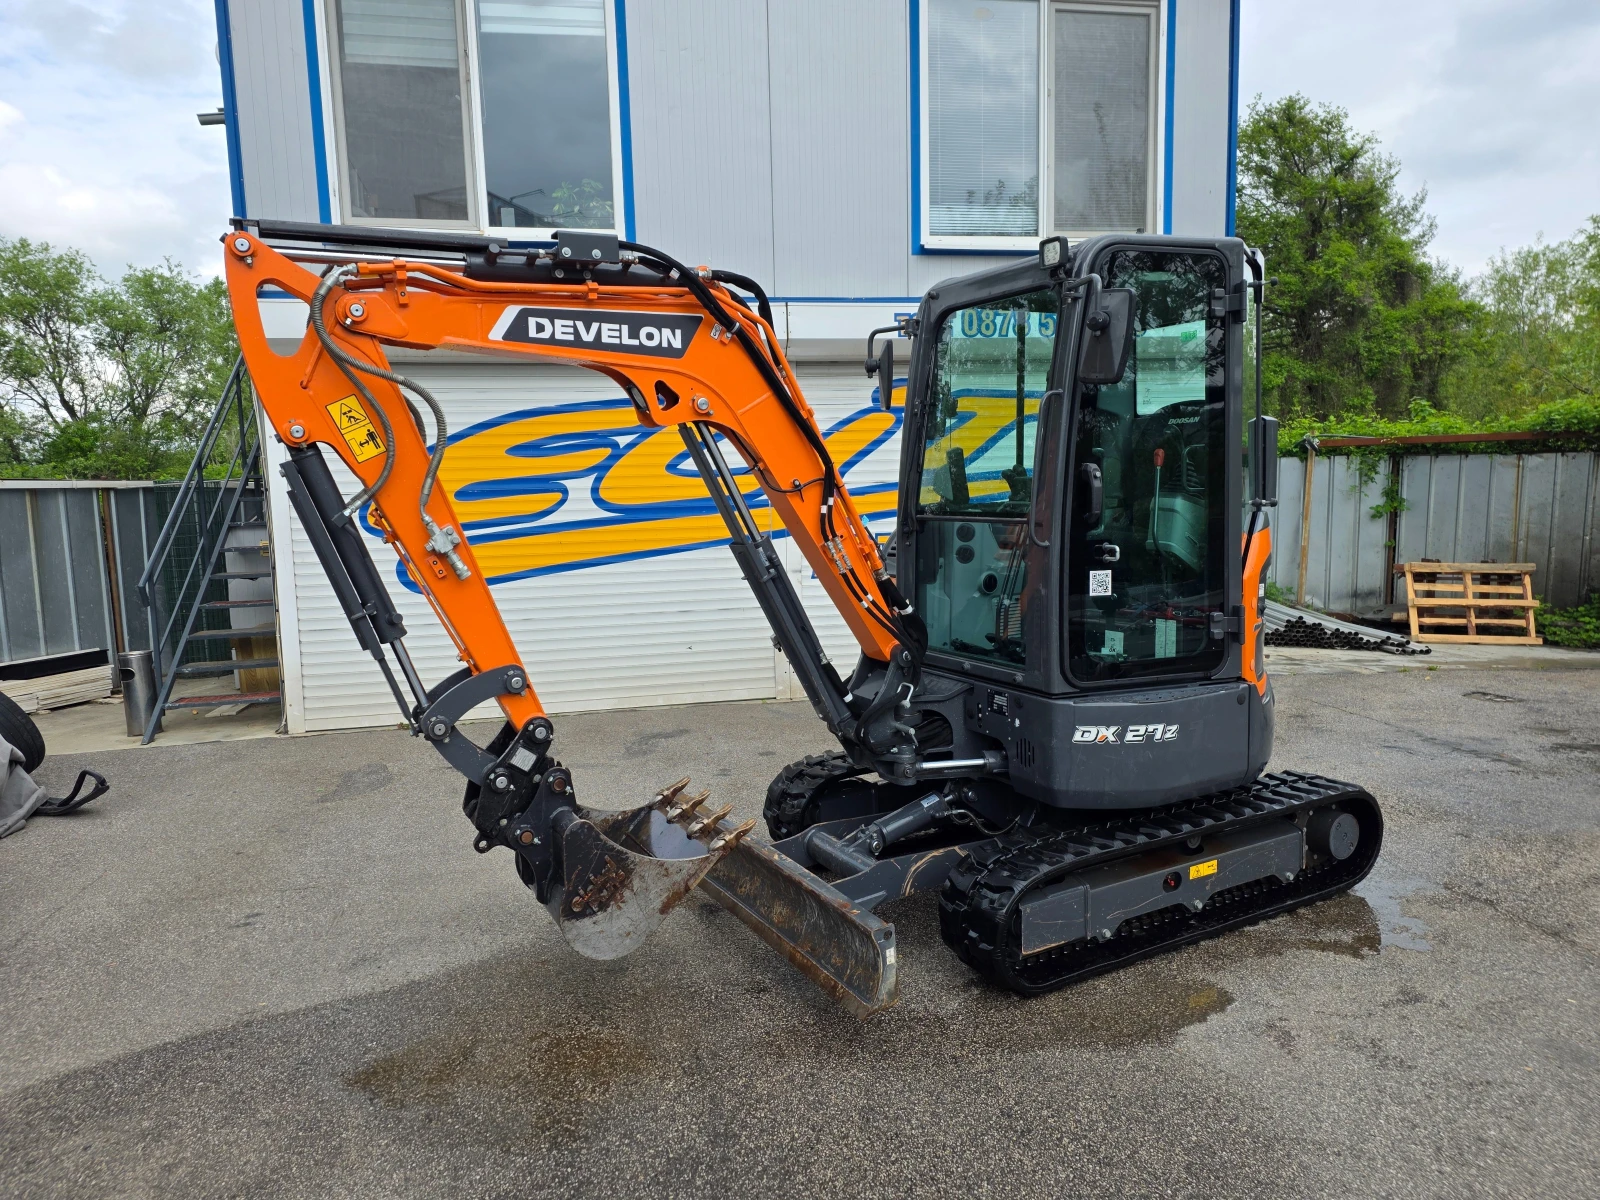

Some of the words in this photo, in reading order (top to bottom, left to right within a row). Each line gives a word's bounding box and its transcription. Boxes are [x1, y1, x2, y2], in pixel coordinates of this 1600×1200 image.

[528, 316, 682, 348] DEVELON
[1168, 416, 1201, 425] DOOSAN
[1072, 725, 1121, 744] DX
